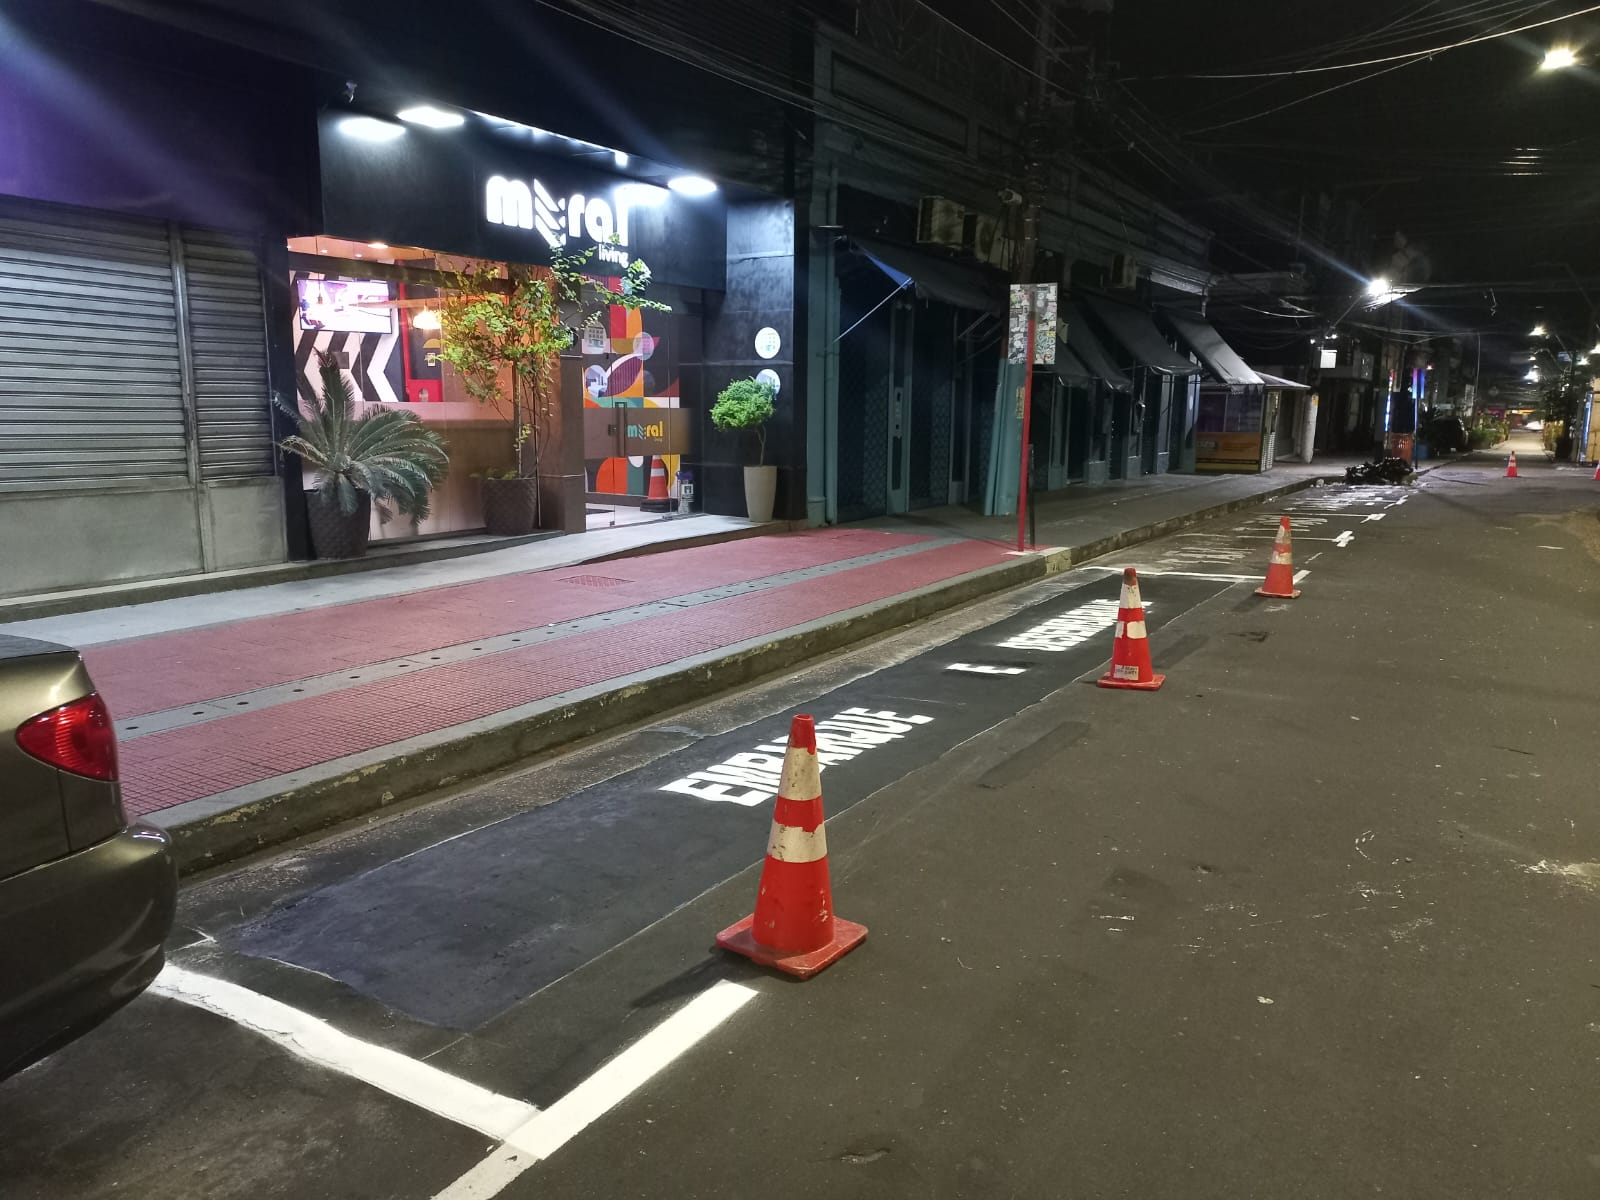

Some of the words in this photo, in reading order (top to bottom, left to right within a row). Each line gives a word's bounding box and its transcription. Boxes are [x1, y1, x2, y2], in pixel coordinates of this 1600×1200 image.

[598, 243, 630, 269] living
[946, 662, 1028, 675] E
[656, 706, 935, 807] EMBARQUE
